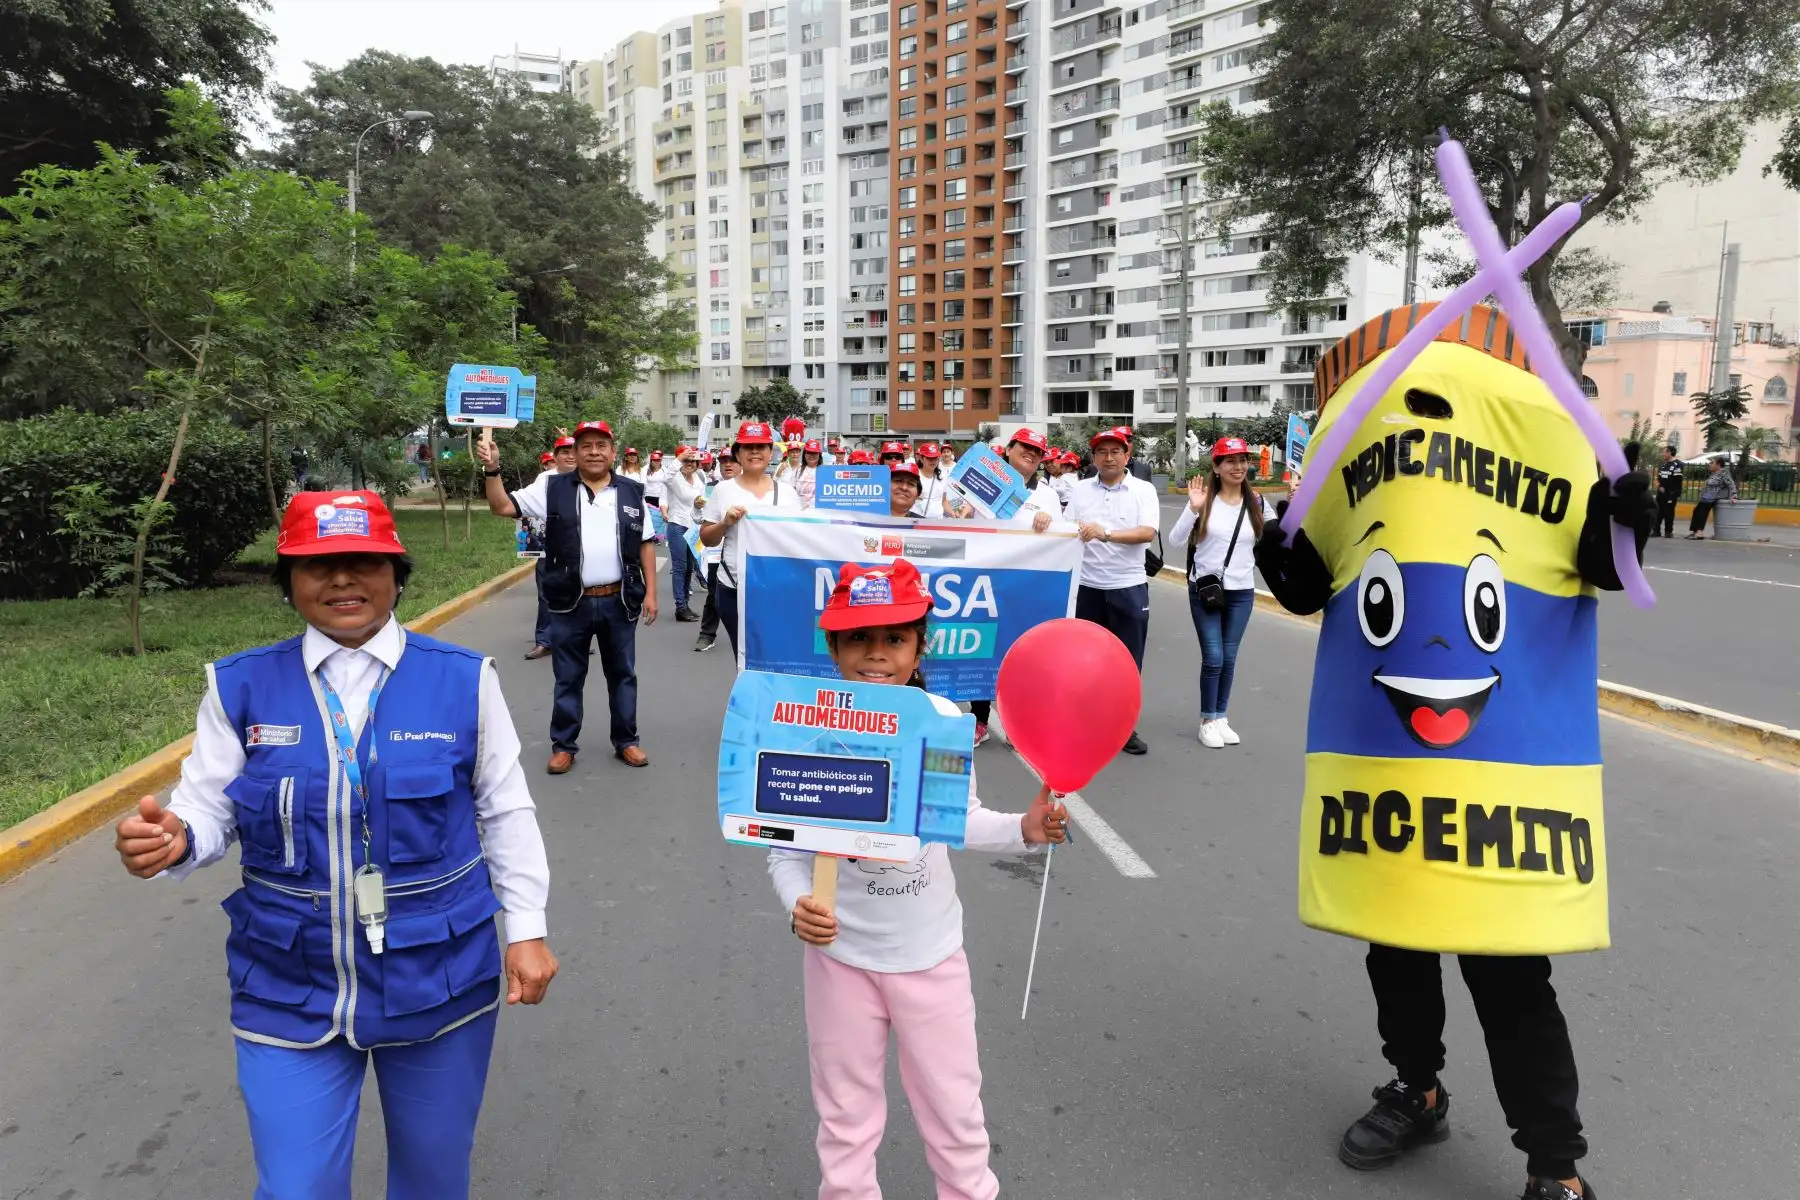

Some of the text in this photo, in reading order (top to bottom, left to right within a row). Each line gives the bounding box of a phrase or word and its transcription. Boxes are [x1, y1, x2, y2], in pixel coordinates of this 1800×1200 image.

[1341, 428, 1572, 525] MEDICAMENTO
[823, 484, 883, 496] DIGEMID
[817, 689, 853, 709] NO TE
[772, 702, 898, 735] AUTOMEDIQUES
[771, 767, 873, 781] Tomar antibióticos sin
[767, 780, 873, 795] receta pone en peligro
[779, 792, 822, 803] Tu salud.
[1318, 789, 1594, 884] DIGEMITO
